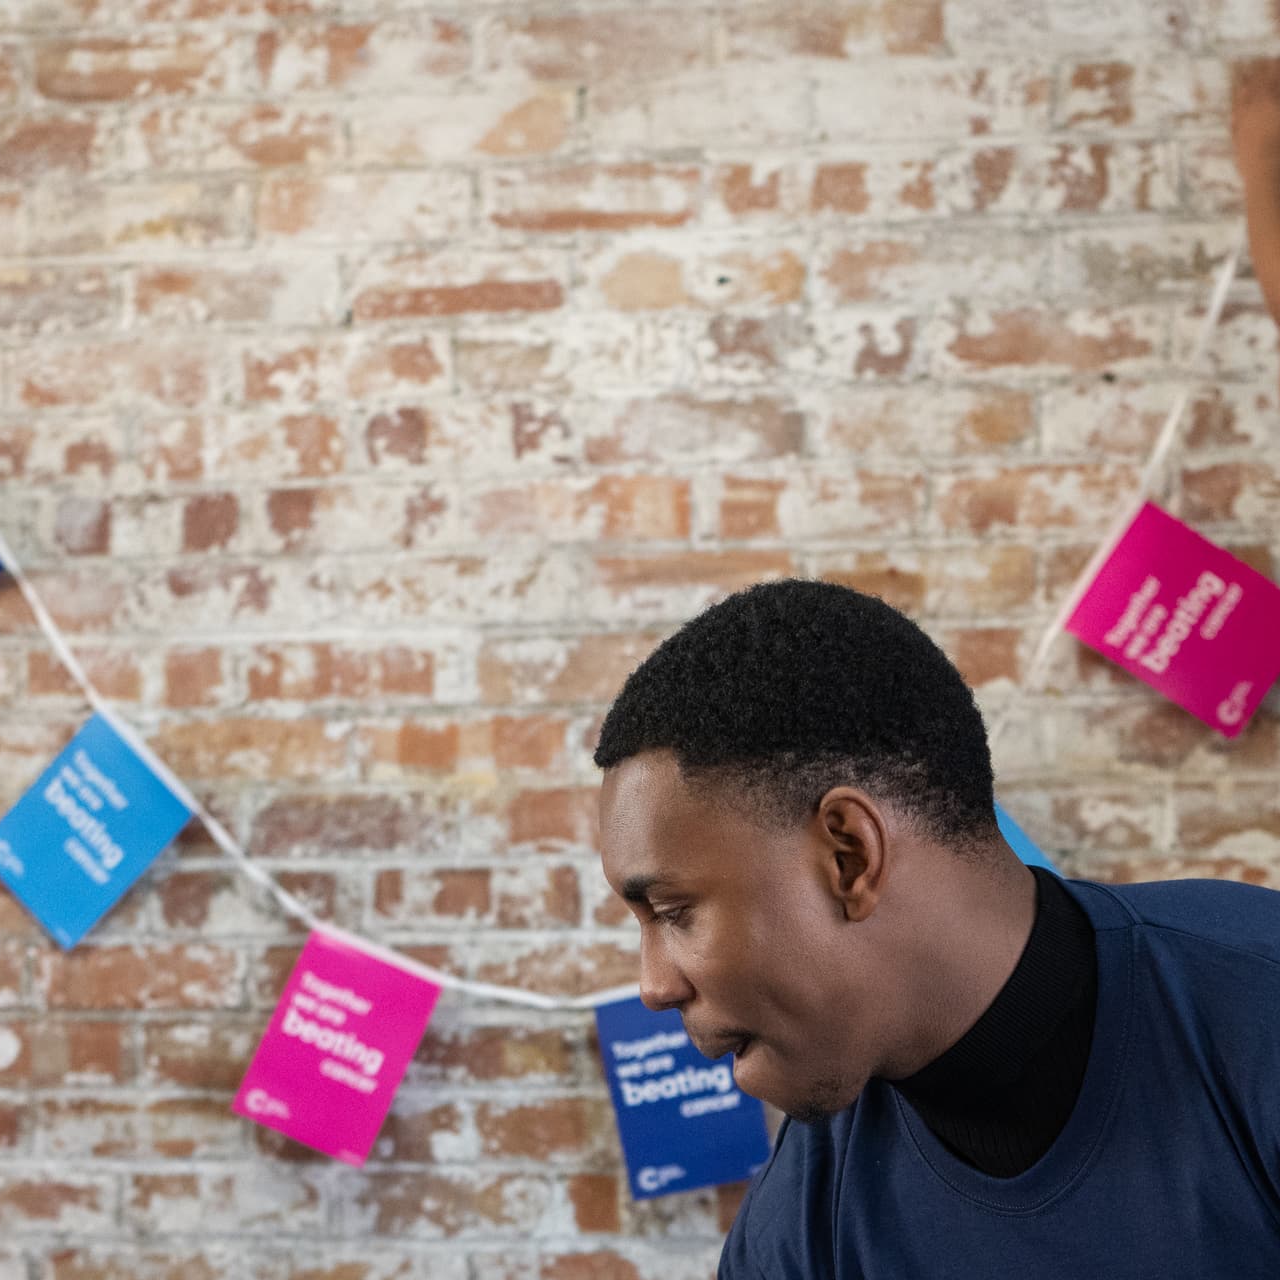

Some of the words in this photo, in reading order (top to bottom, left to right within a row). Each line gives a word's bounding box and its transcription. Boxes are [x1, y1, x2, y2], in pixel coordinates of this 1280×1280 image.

[1138, 570, 1226, 673] beating
[44, 777, 124, 869] beating
[281, 1006, 386, 1077] beating
[612, 1032, 689, 1060] Together
[621, 1064, 733, 1107] beating
[680, 1092, 741, 1118] cancer
